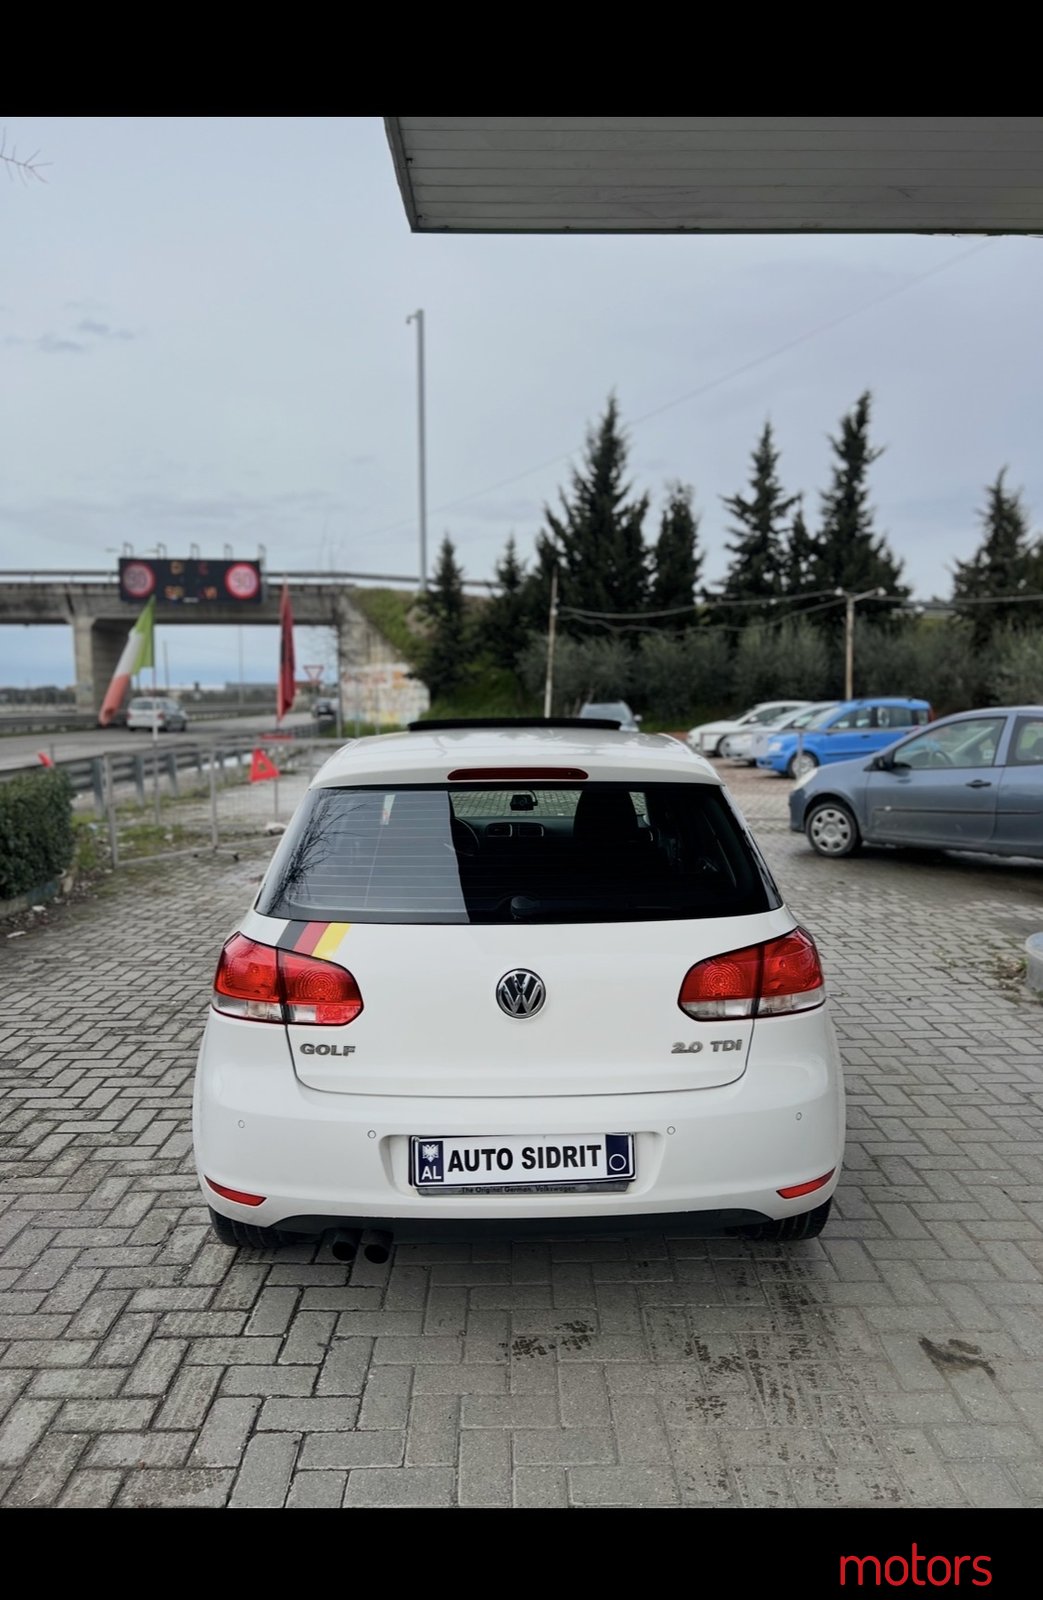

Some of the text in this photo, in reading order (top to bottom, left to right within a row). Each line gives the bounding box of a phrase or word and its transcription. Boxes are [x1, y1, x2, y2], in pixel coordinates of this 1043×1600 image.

[299, 1043, 356, 1057] GOLF
[710, 1039, 743, 1052] TDI
[447, 1144, 602, 1172] AUTO SIDRIT
[421, 1166, 442, 1180] AL
[475, 1186, 503, 1194] Original
[536, 1185, 576, 1193] Volkswagen
